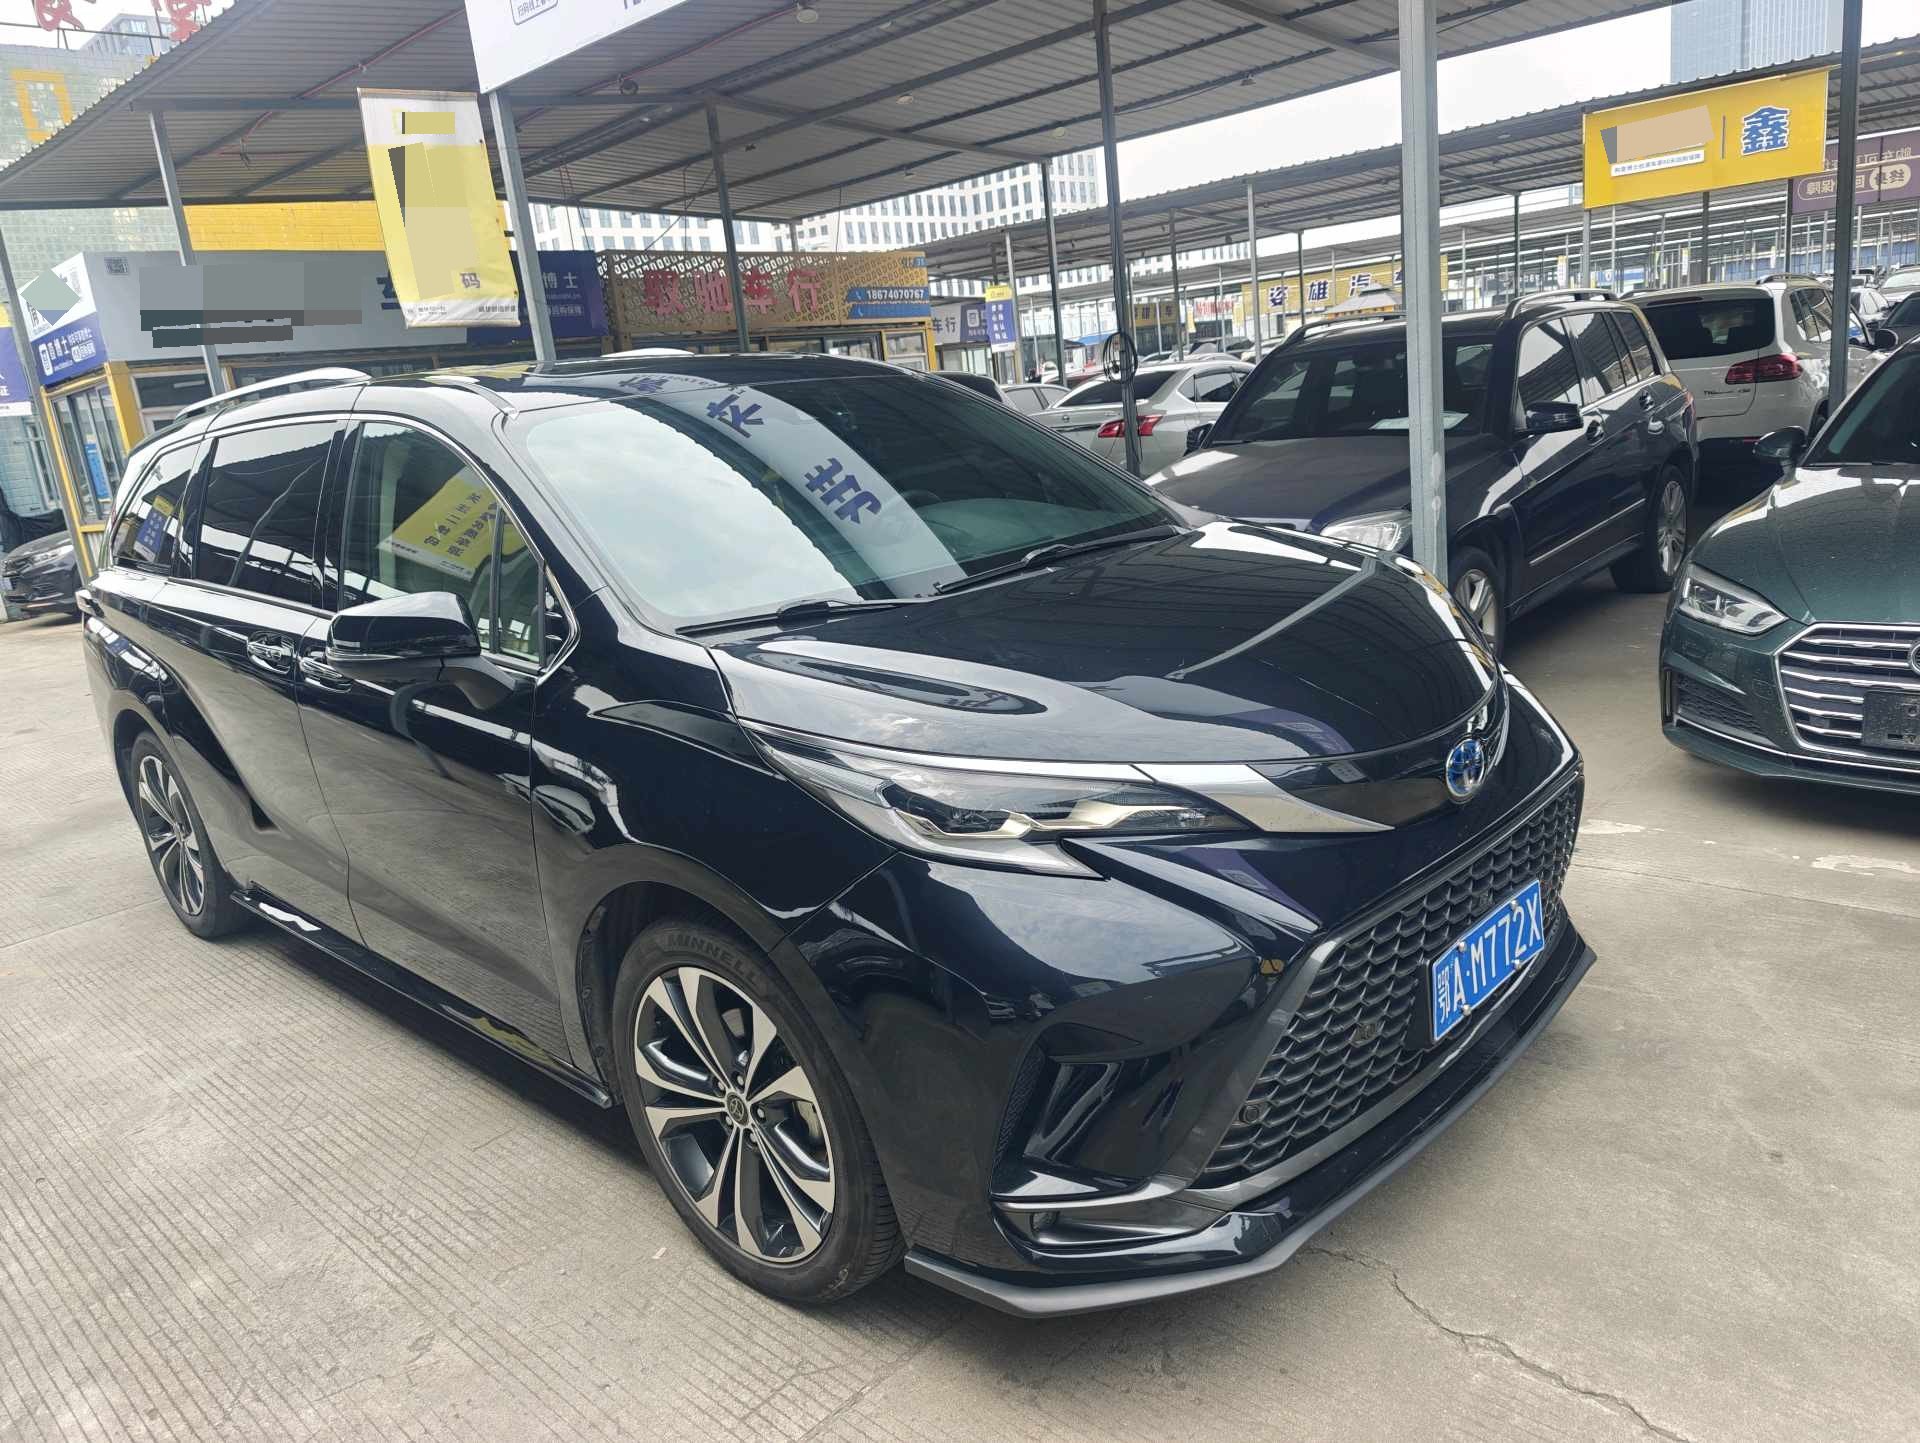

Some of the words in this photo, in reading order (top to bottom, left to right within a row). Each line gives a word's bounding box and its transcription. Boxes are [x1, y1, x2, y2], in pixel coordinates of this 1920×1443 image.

[1742, 106, 1789, 155] 鑫
[460, 272, 480, 289] 码
[866, 289, 924, 300] 18674070767
